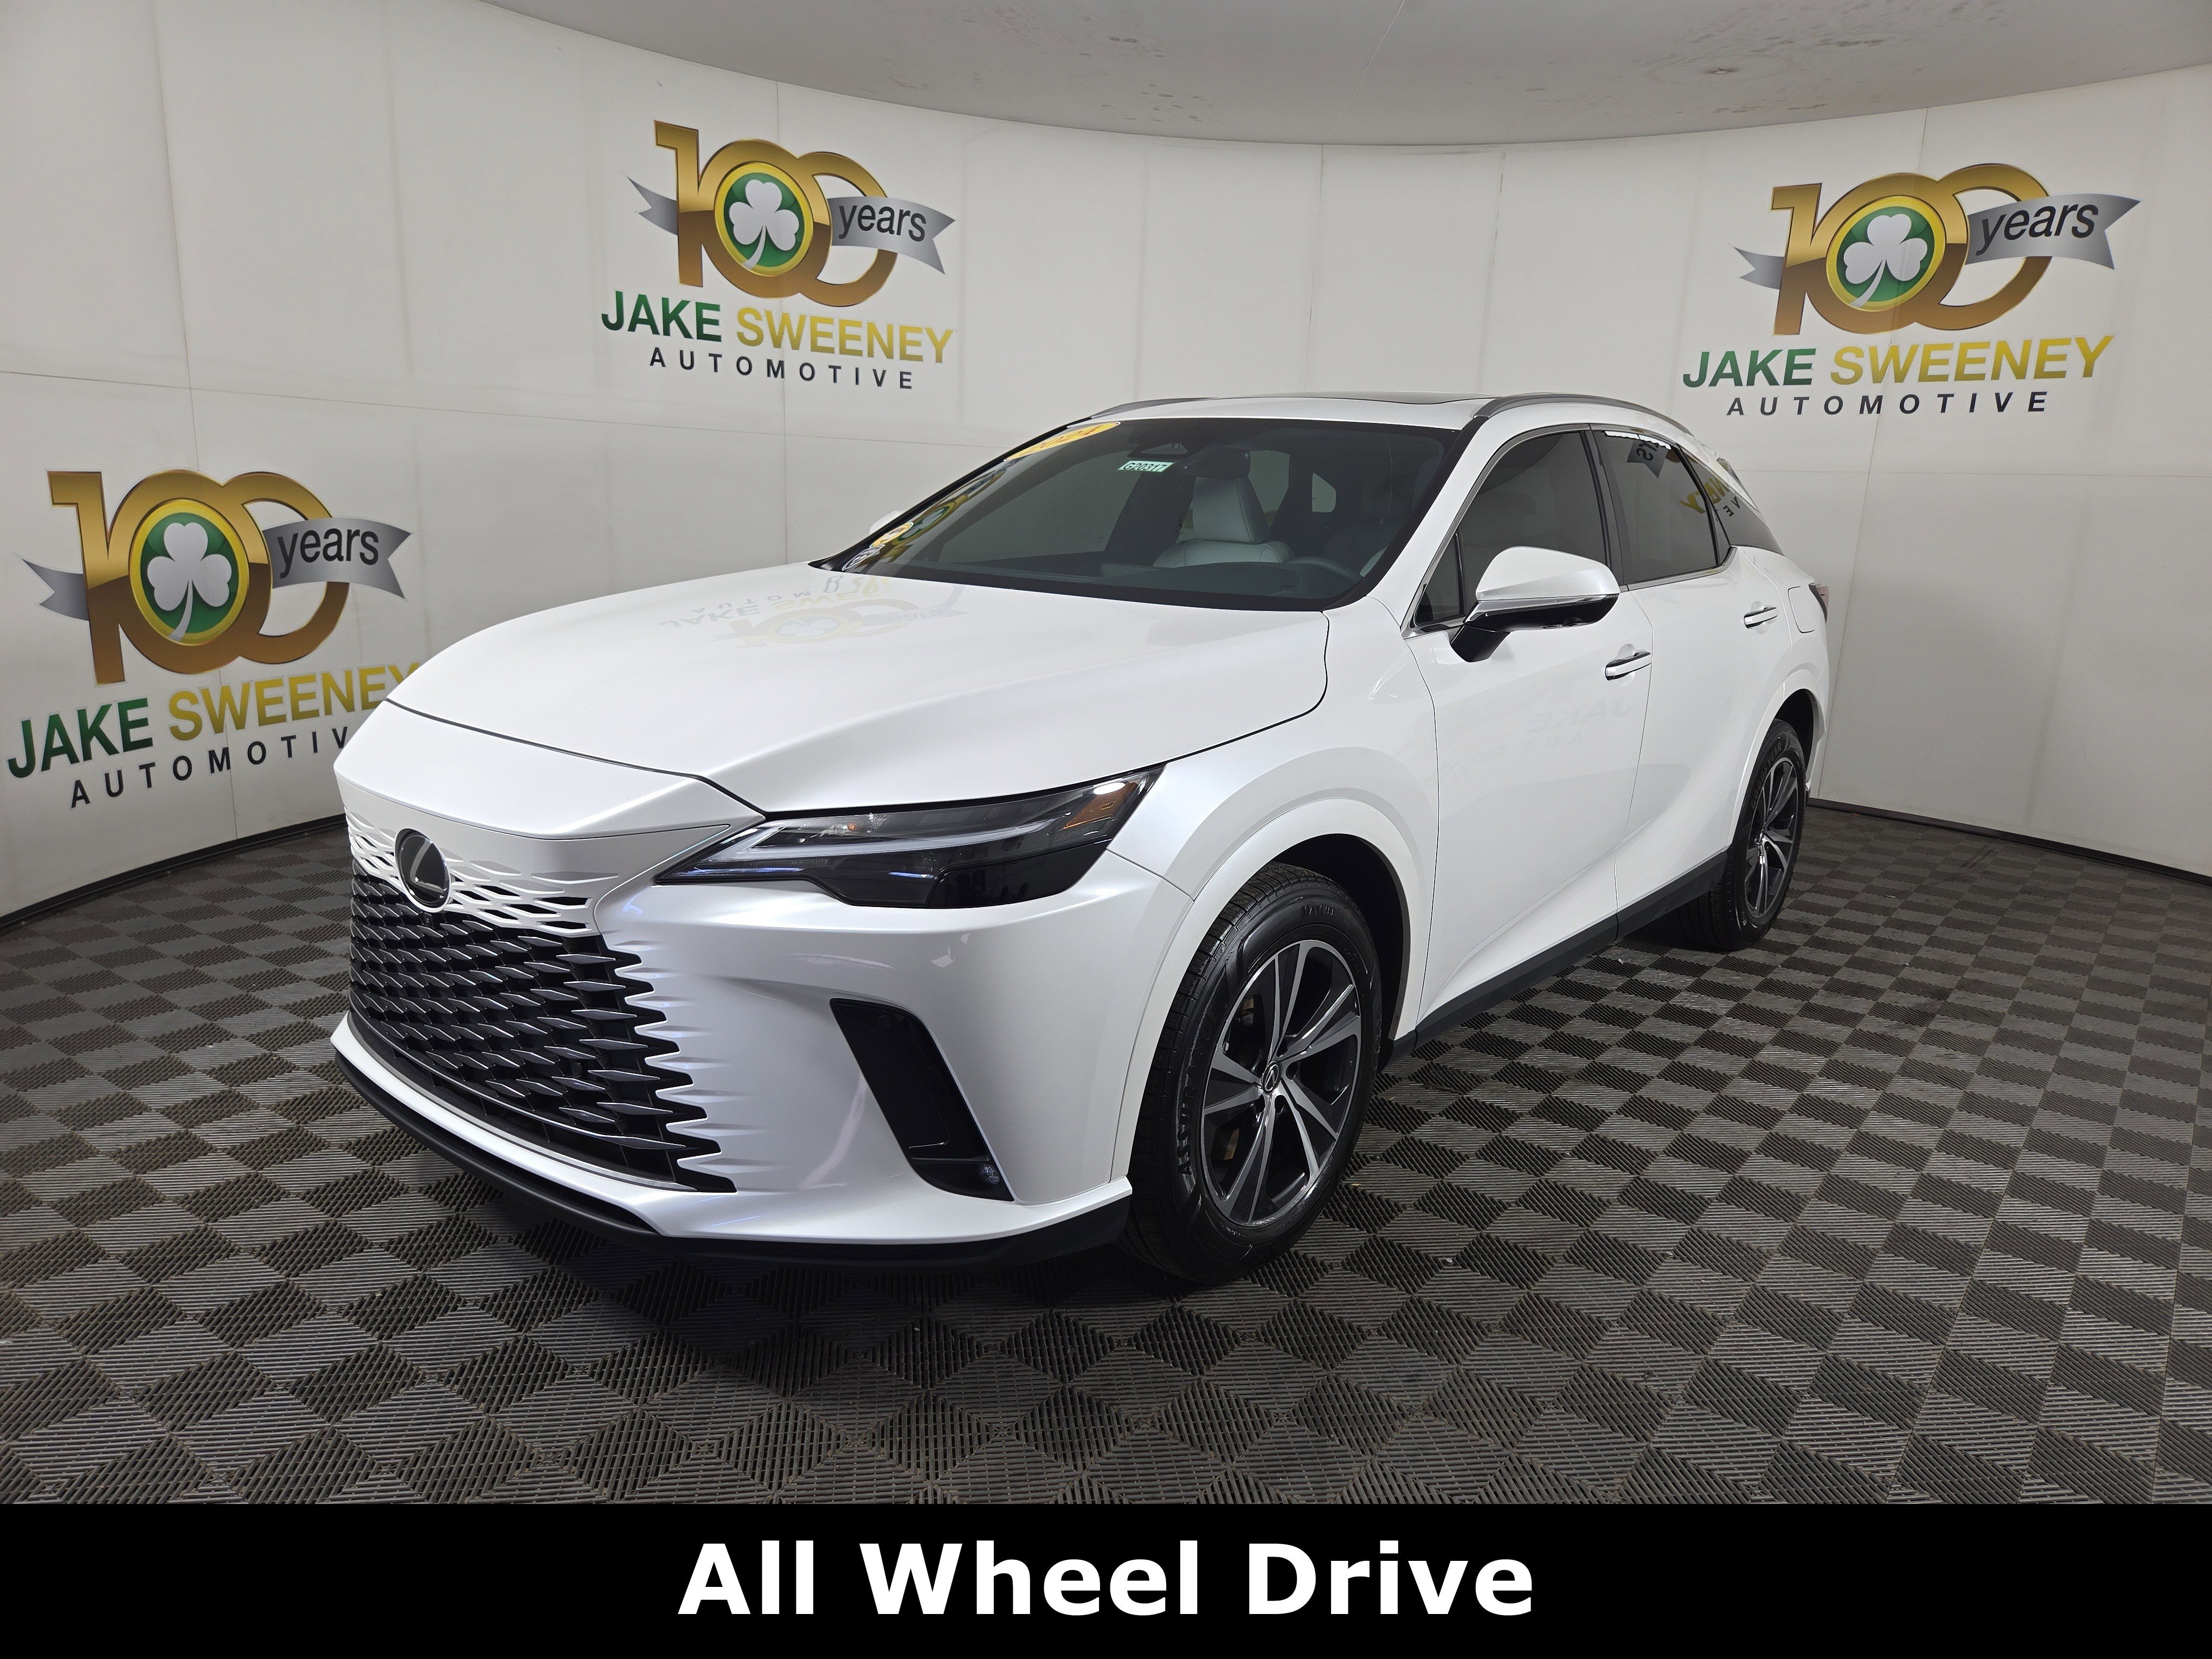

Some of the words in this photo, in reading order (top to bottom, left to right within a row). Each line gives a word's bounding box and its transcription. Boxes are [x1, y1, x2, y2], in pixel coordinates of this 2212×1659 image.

[654, 120, 898, 307] 100
[839, 204, 928, 242] years
[1976, 202, 2099, 256] years
[1769, 163, 2054, 336] 100
[601, 290, 722, 342] JAKE
[736, 307, 954, 363] SWEENEY
[650, 347, 912, 390] AUTOMOTIVE
[1682, 348, 1816, 388] JAKE
[1830, 335, 2115, 385] SWEENEY
[1726, 391, 2049, 416] AUTOMOTIVE
[1123, 462, 1167, 472] G20317
[47, 470, 350, 685] 100
[277, 528, 380, 579] years
[8, 697, 154, 779] JAKE
[70, 726, 348, 809] AUTOMOTIV
